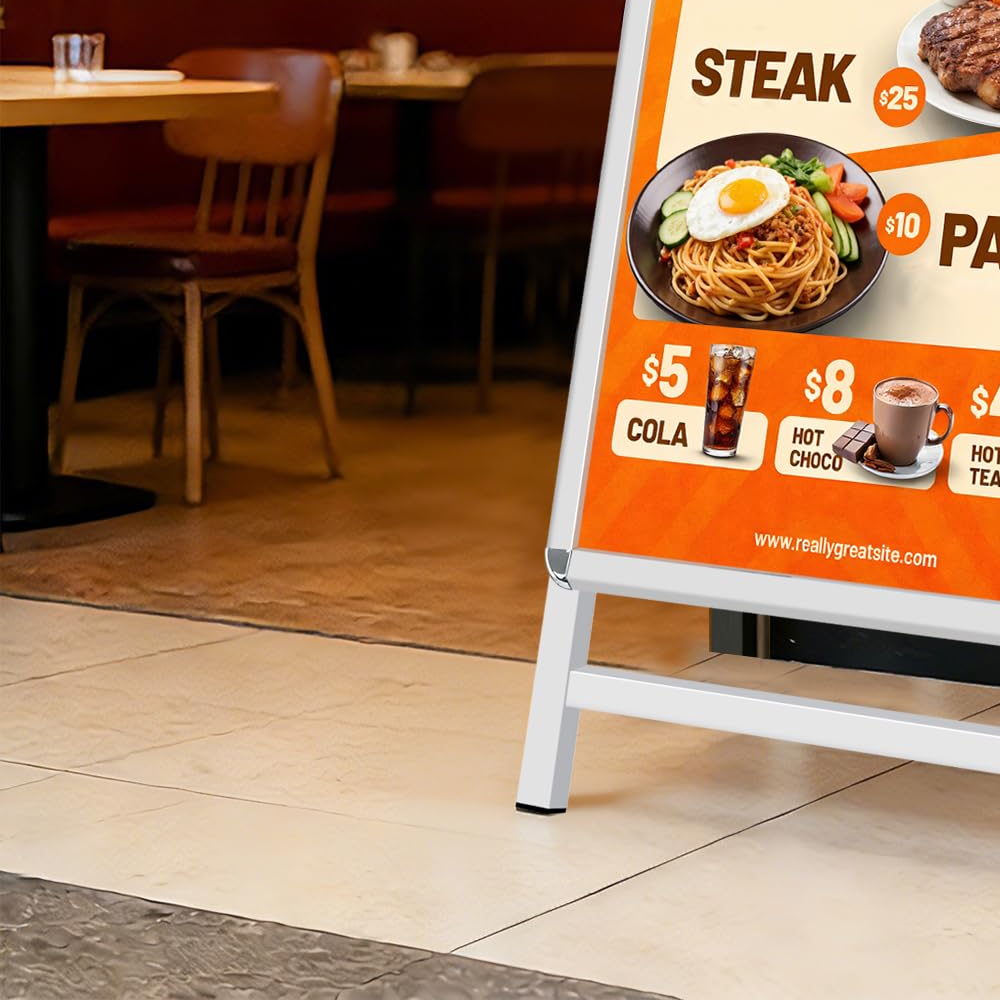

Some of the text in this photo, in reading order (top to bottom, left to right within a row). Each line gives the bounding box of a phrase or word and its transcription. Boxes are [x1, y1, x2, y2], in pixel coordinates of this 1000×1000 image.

[691, 47, 857, 104] STEAK
[879, 85, 919, 111] $25
[885, 211, 921, 239] $10
[641, 344, 692, 398] $5
[803, 359, 856, 415] $8
[626, 417, 689, 448] COLA
[792, 426, 825, 447] HOT
[789, 449, 843, 472] CHOCO
[754, 532, 937, 568] www.reallygreatsite.com
